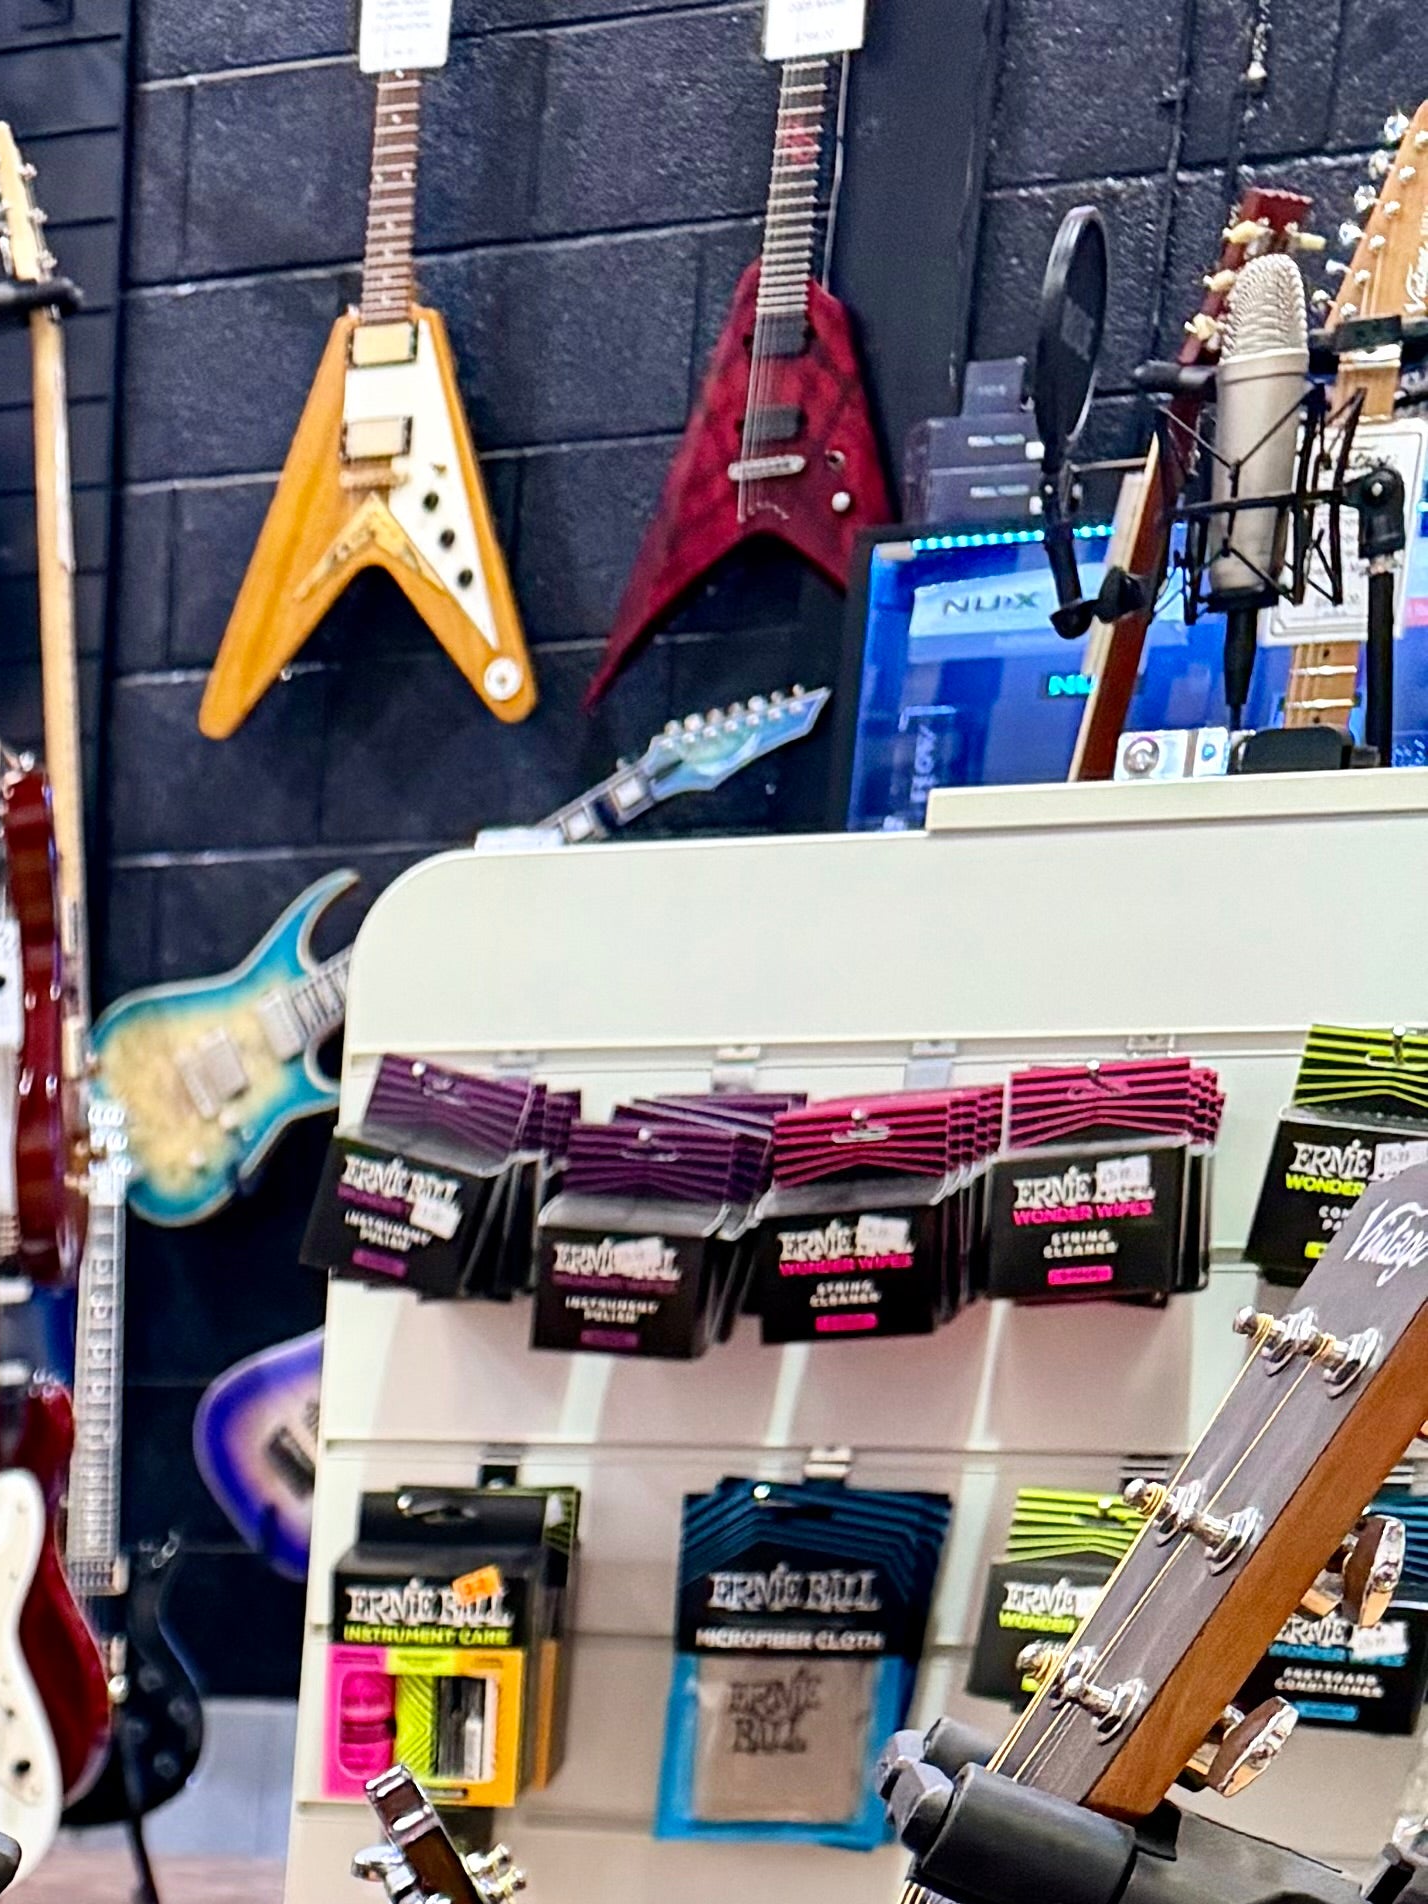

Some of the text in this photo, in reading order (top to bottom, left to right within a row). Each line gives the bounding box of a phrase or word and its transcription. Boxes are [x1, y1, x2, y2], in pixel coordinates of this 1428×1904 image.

[1289, 1139, 1373, 1180] ERNIE
[1013, 1165, 1092, 1210] ERNIE
[1286, 1172, 1366, 1197] WONDER
[1012, 1200, 1153, 1226] WONDER WIPES
[777, 1218, 855, 1263] ERNIE
[1051, 1228, 1111, 1246] STRING
[553, 1236, 619, 1277] ERNI
[1043, 1241, 1119, 1260] CLEANER
[779, 1254, 914, 1278] WONDER WIPES
[705, 1561, 884, 1614] ERNIE BALL
[345, 1577, 438, 1626] ERNIE
[344, 1624, 512, 1646] INSTRUMENT CARE
[814, 1629, 888, 1651] CLOTH
